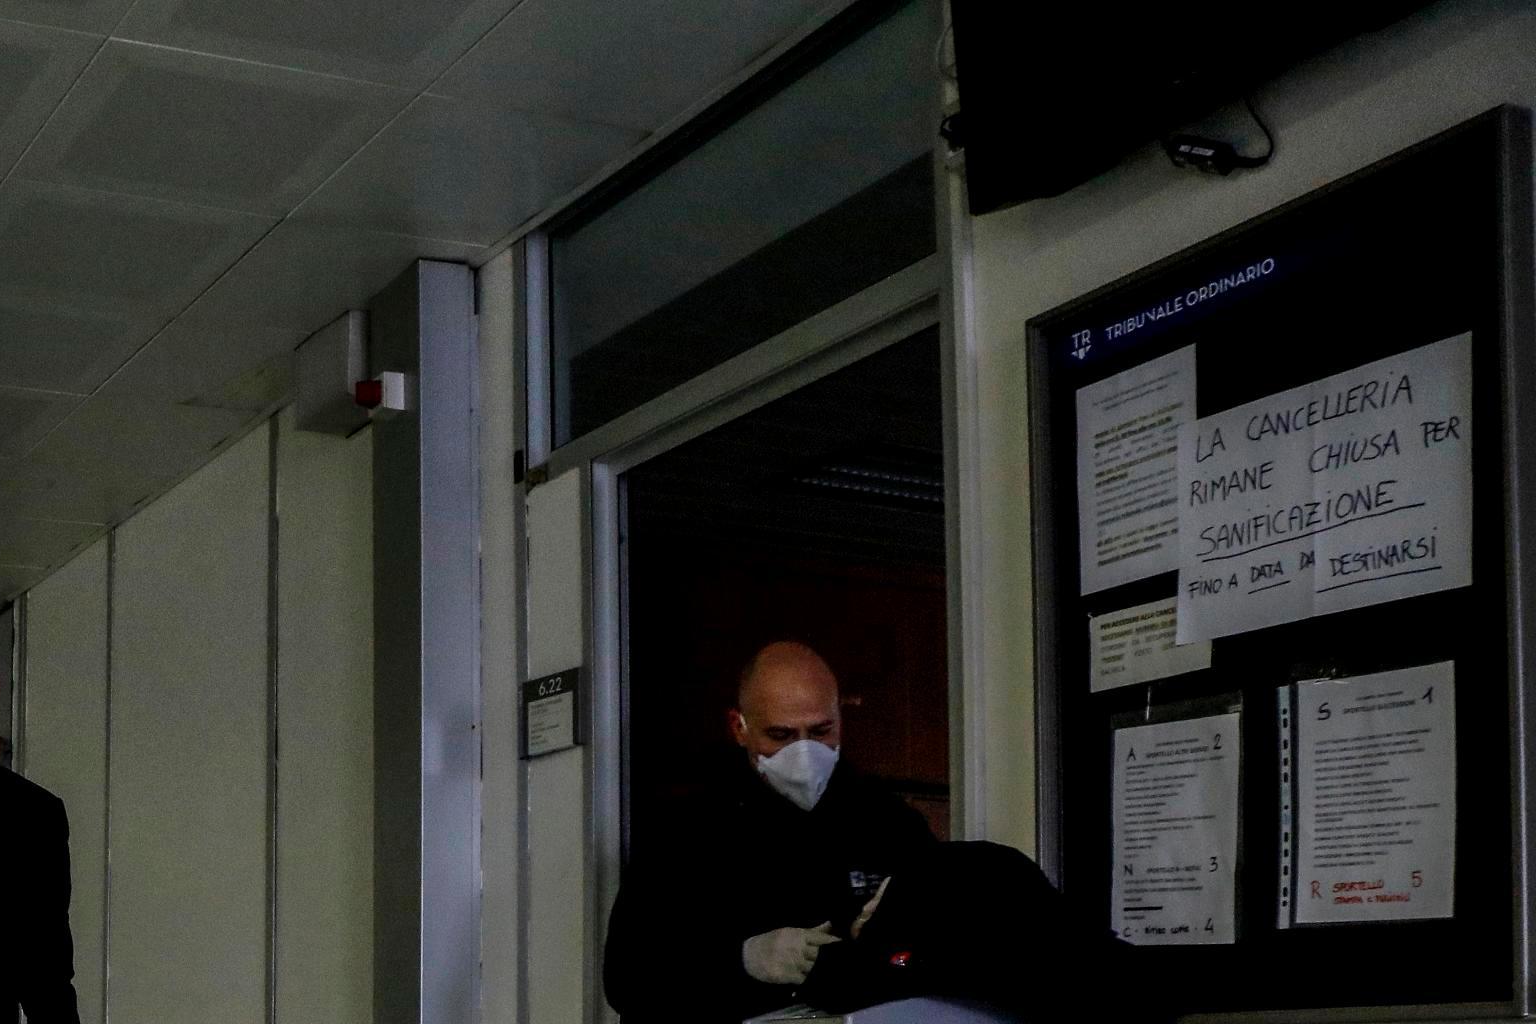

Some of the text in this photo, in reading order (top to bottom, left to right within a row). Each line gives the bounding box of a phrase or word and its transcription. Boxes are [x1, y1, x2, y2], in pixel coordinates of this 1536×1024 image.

[1105, 258, 1275, 341] TRIBUNALE ORDINARIO
[1196, 428, 1225, 463] LA
[1246, 371, 1413, 441] CANCELLERIA
[1190, 462, 1274, 506] RIMANE
[1308, 430, 1400, 473] CHIUSA
[1421, 415, 1460, 448] PER
[1196, 480, 1397, 556] SANIFICAZIONE
[1189, 574, 1223, 599] FINO
[1228, 574, 1238, 589] A
[1249, 562, 1284, 584] DATA
[1329, 527, 1438, 577] DESTINARSI
[539, 676, 562, 697] 6.22
[1422, 686, 1434, 704] 1
[1317, 702, 1331, 721] S
[1213, 733, 1222, 751] 2
[1126, 747, 1136, 762] A
[1124, 863, 1133, 876] N
[1209, 856, 1218, 872] 3
[1310, 880, 1321, 899] R
[1411, 869, 1423, 888] 5
[1204, 917, 1215, 934] 4
